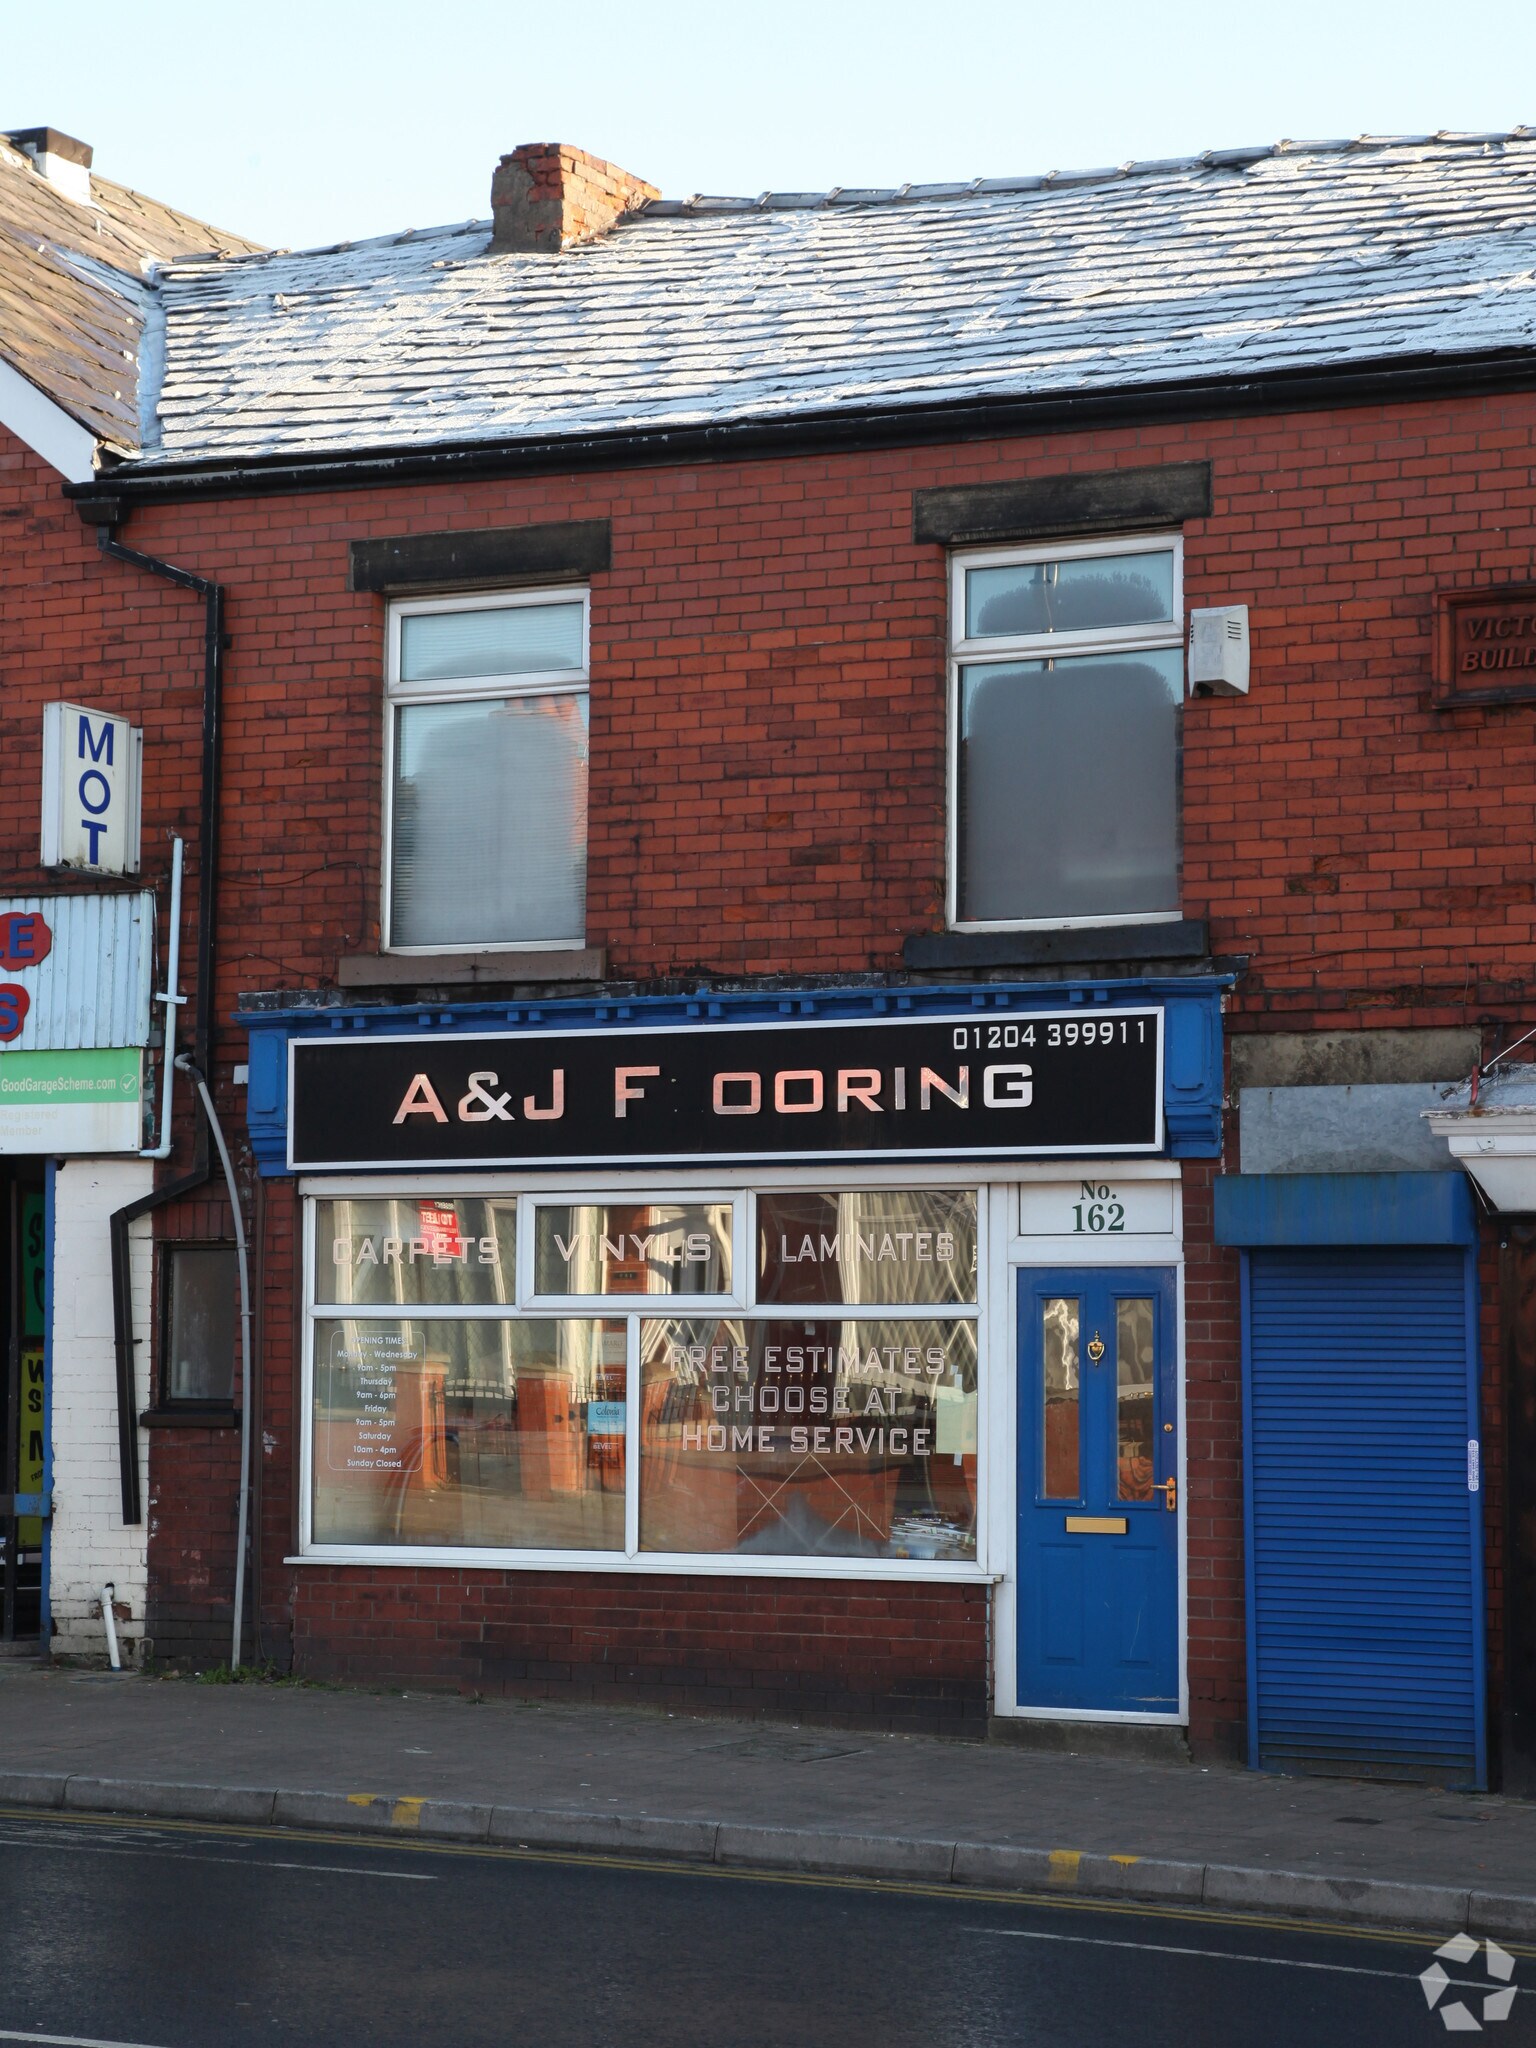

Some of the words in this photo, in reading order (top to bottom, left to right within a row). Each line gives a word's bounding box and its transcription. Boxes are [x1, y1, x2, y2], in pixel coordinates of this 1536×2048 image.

[78, 715, 115, 866] MOT
[953, 1024, 1037, 1050] 01204
[1047, 1020, 1146, 1047] 399911
[1, 1077, 117, 1095] GoodGarageScheme.com
[392, 1067, 565, 1124] A&J
[1080, 1179, 1117, 1200] No.
[1072, 1203, 1125, 1232] 162
[332, 1237, 499, 1265] CARPETS
[553, 1233, 711, 1262] VINYLS
[781, 1232, 954, 1263] LAMINATES
[385, 1336, 406, 1345] TIMES
[374, 1350, 418, 1360] Wednesday
[670, 1345, 750, 1373] FREE
[764, 1346, 946, 1375] ESTIMATES
[357, 1364, 374, 1372] 9am
[380, 1364, 397, 1373] 5pm
[360, 1377, 392, 1387] Thursday
[356, 1391, 373, 1399] 9am
[379, 1391, 396, 1400] 6pm
[712, 1385, 850, 1414] CHOOSE
[863, 1387, 902, 1415] AT
[364, 1404, 387, 1414] Friday
[355, 1418, 372, 1426] 9am
[379, 1418, 395, 1427] 5pm
[359, 1431, 391, 1441] Saturday
[682, 1424, 775, 1452] HOME
[789, 1426, 931, 1456] SERVICE
[353, 1445, 373, 1453] 10am
[380, 1445, 397, 1454] 4pm
[347, 1459, 373, 1468] Sunday
[376, 1459, 402, 1467] Closed
